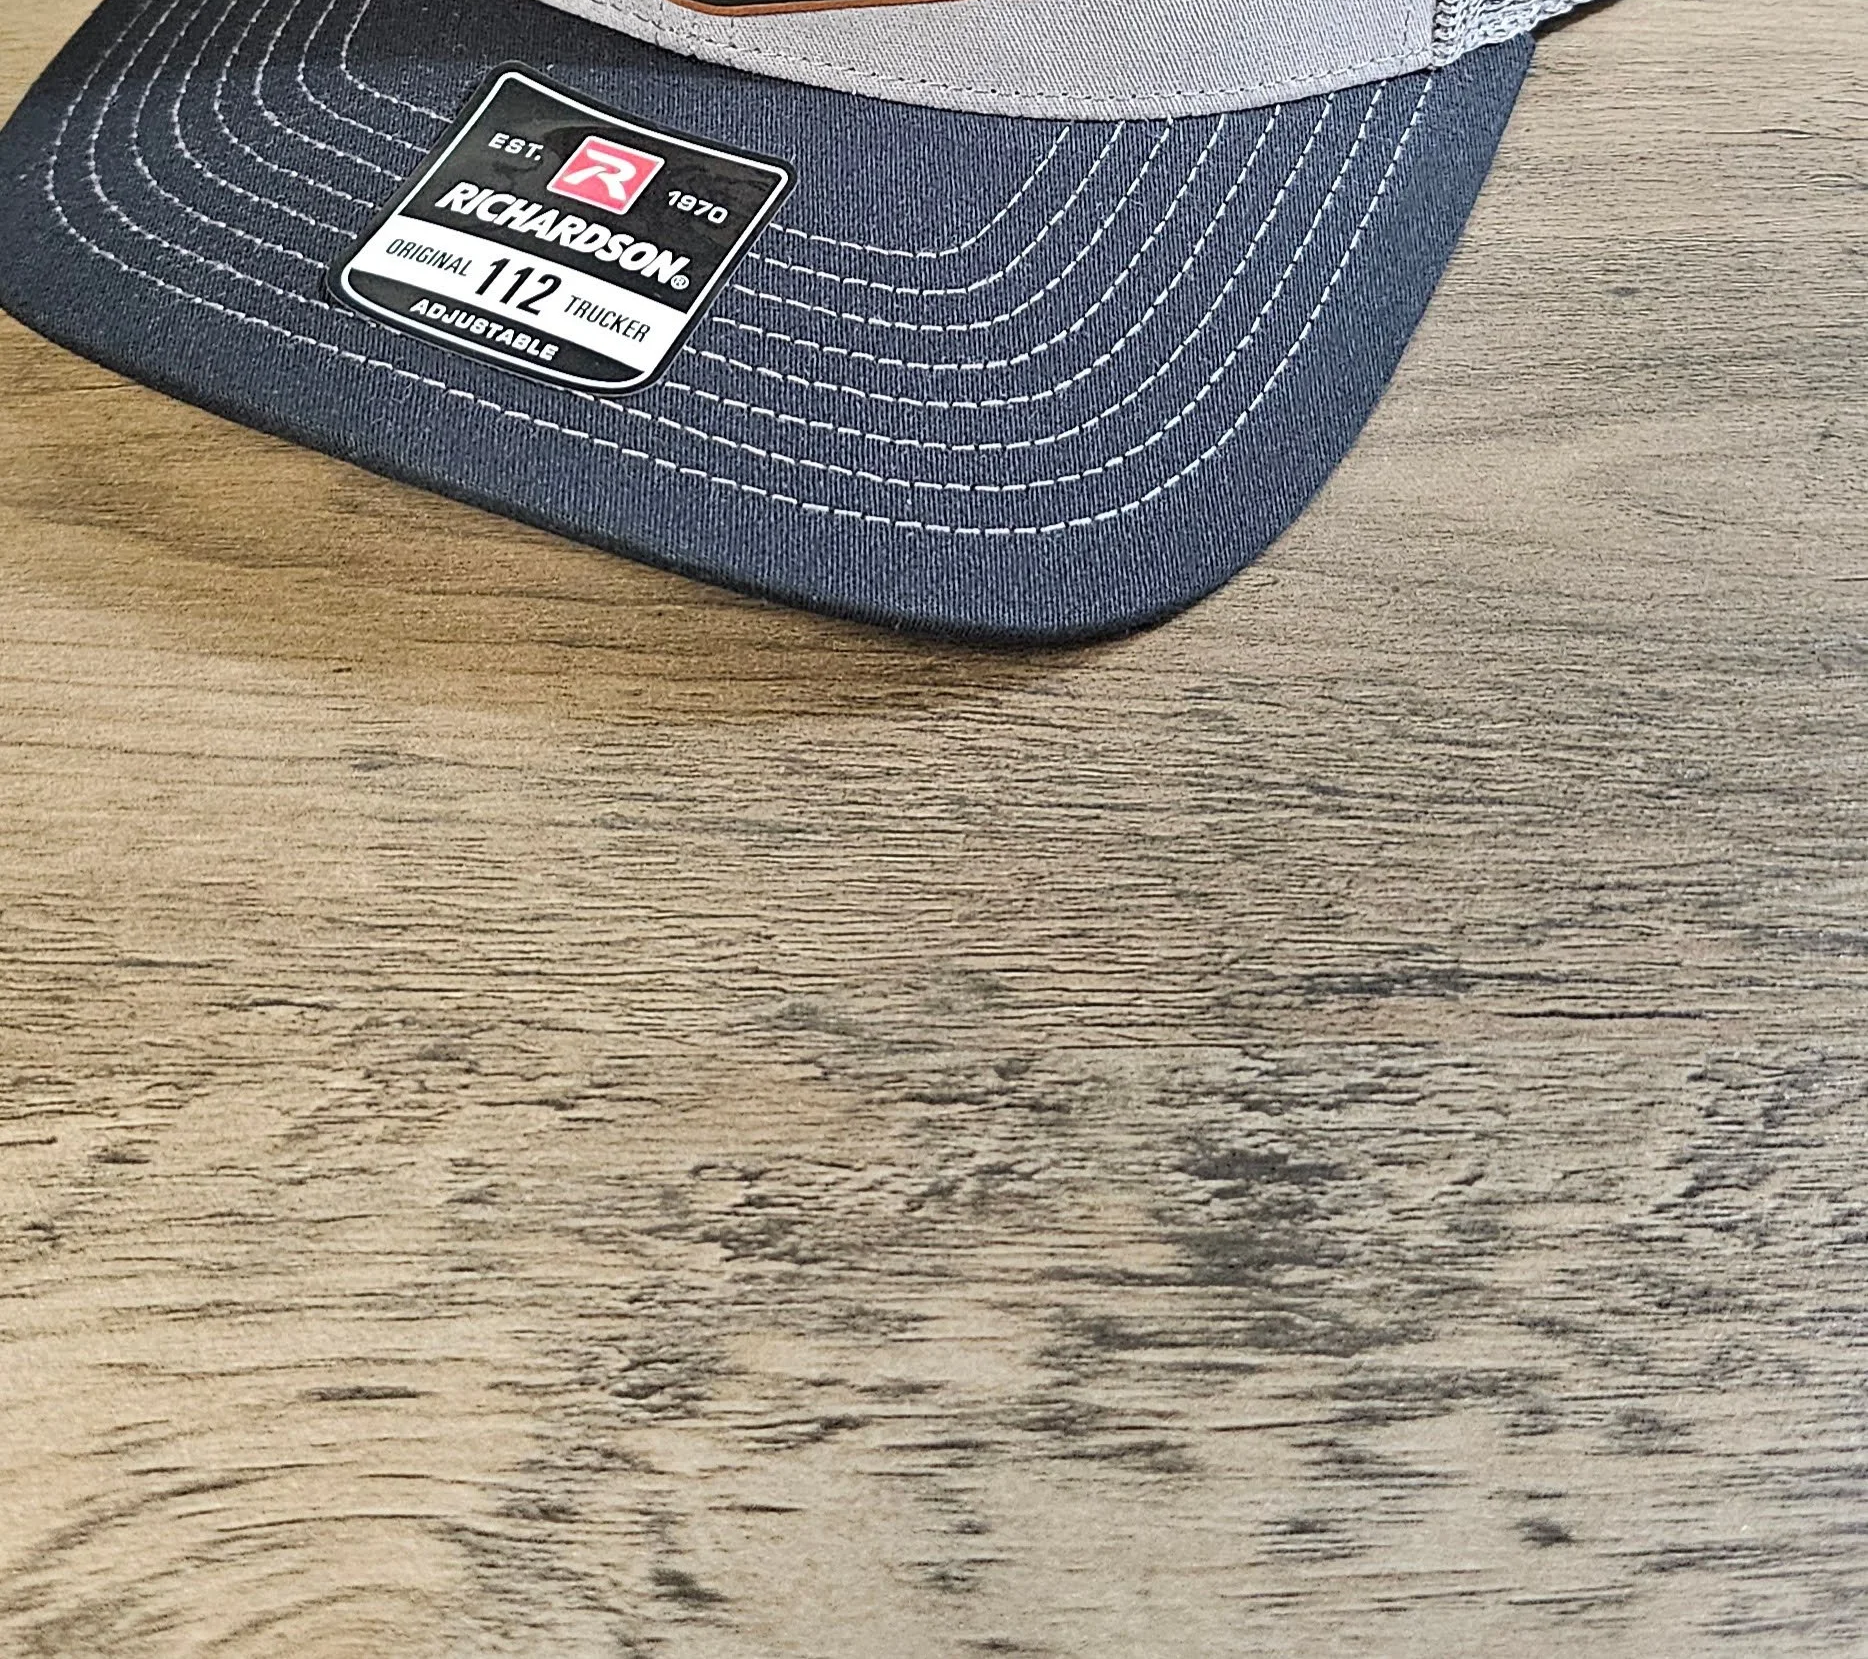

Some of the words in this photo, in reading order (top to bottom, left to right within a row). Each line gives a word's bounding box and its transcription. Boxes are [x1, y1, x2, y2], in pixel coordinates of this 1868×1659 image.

[488, 132, 543, 161] EST.
[666, 189, 729, 224] 1970
[386, 238, 468, 278] ORIGINAL
[475, 258, 562, 316] 112
[564, 294, 651, 343] TRUCKER
[410, 298, 559, 361] ADJUSTABLE
